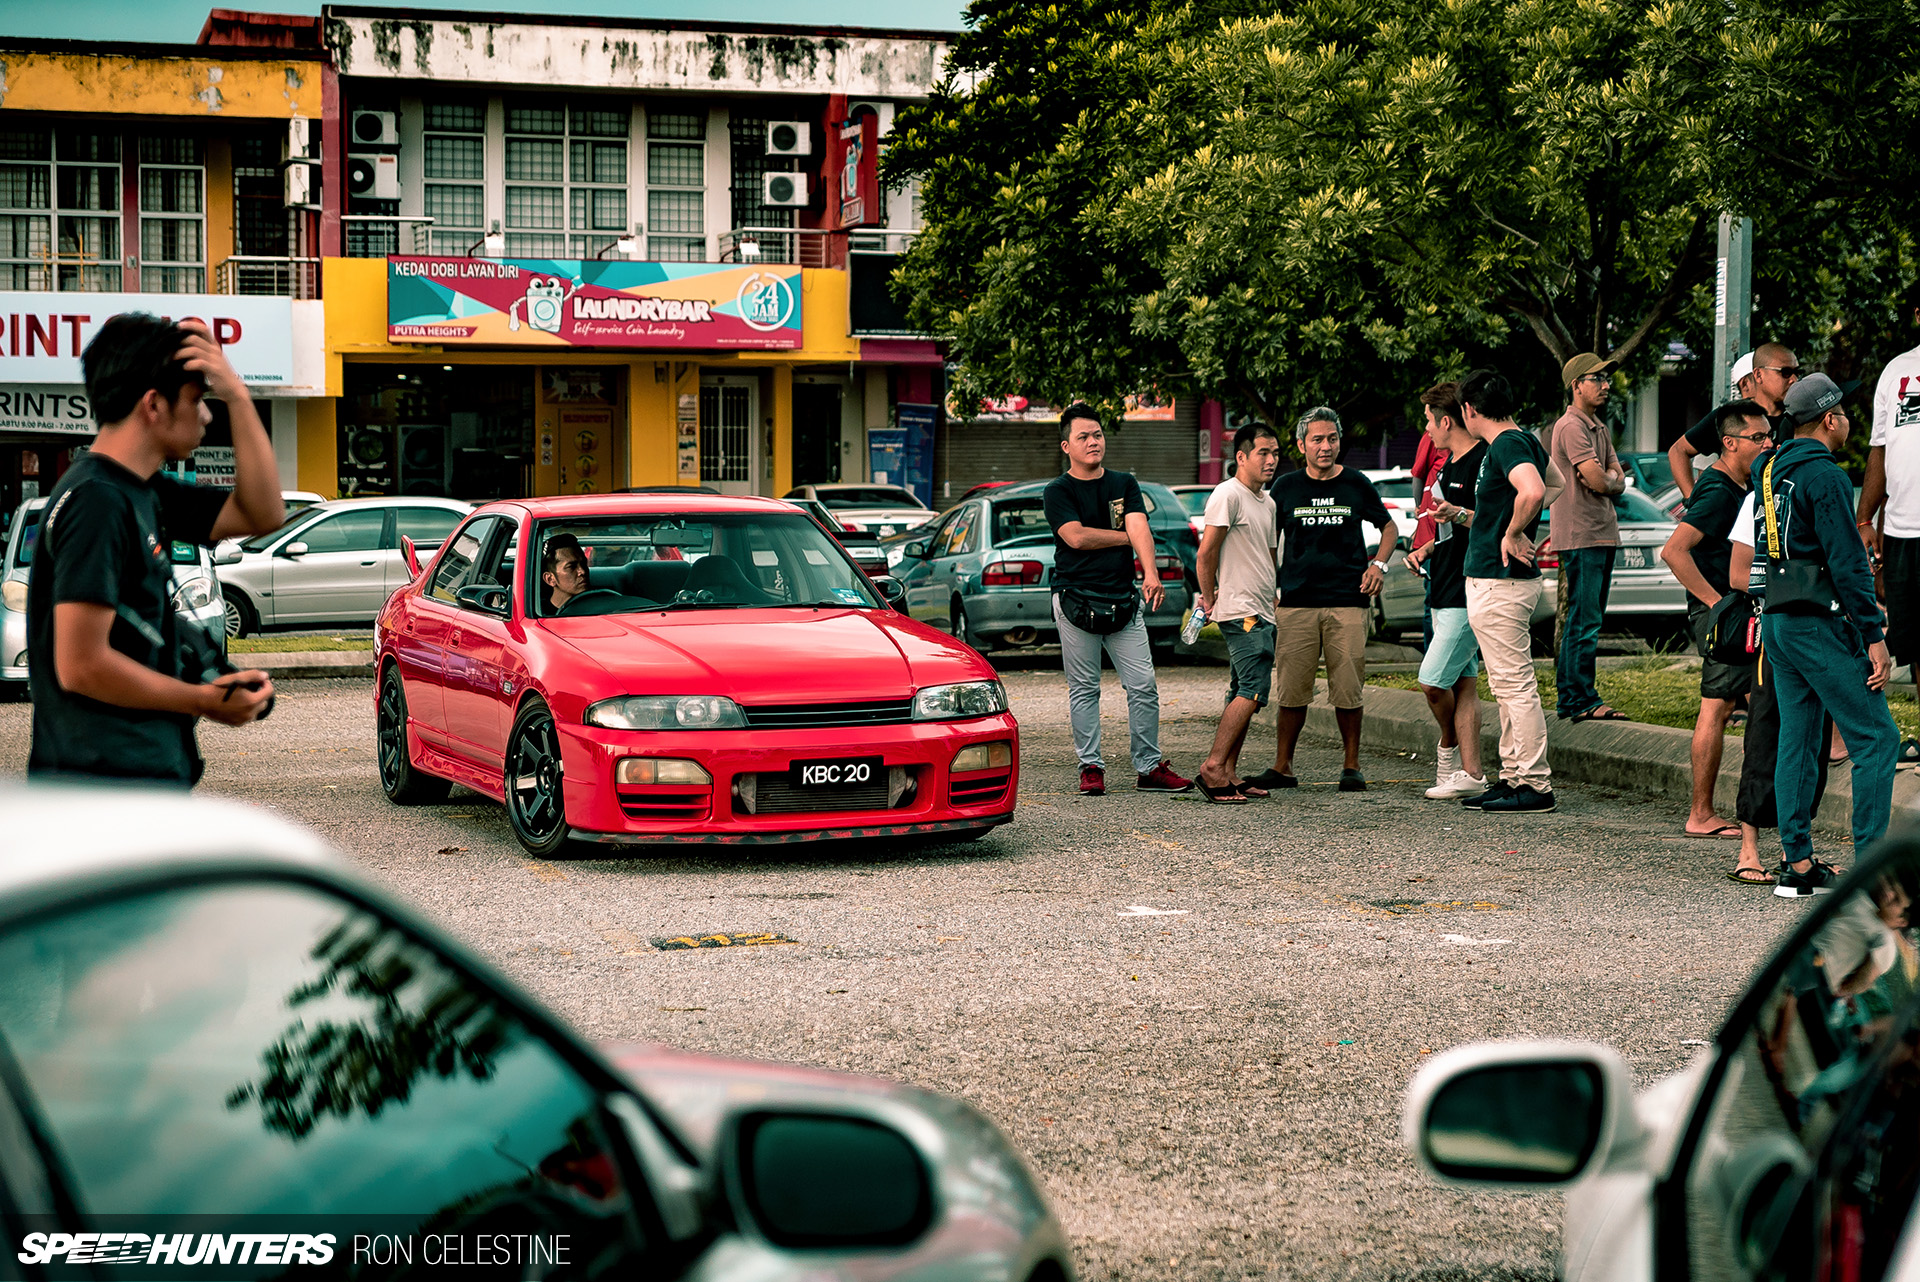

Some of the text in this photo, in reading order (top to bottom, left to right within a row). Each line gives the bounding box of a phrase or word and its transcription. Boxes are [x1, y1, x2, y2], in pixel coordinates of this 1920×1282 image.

[395, 262, 519, 279] KEDAI DOBI LAYAN DIRI
[752, 281, 779, 304] 24
[573, 296, 712, 322] LAUNDRYBAR
[752, 303, 779, 317] JAM
[0, 313, 91, 357] INT
[394, 327, 468, 336] PUTRA HEIGHTS
[573, 322, 685, 340] Self-service Coin Laundry
[37, 421, 55, 429] PAGI
[75, 423, 89, 431] PTG
[194, 450, 220, 459] PRINT
[195, 464, 235, 475] SERVICES
[214, 476, 220, 484] &
[1311, 497, 1335, 506] TIME
[1301, 516, 1343, 526] TO PASS
[802, 763, 870, 784] KBC 20
